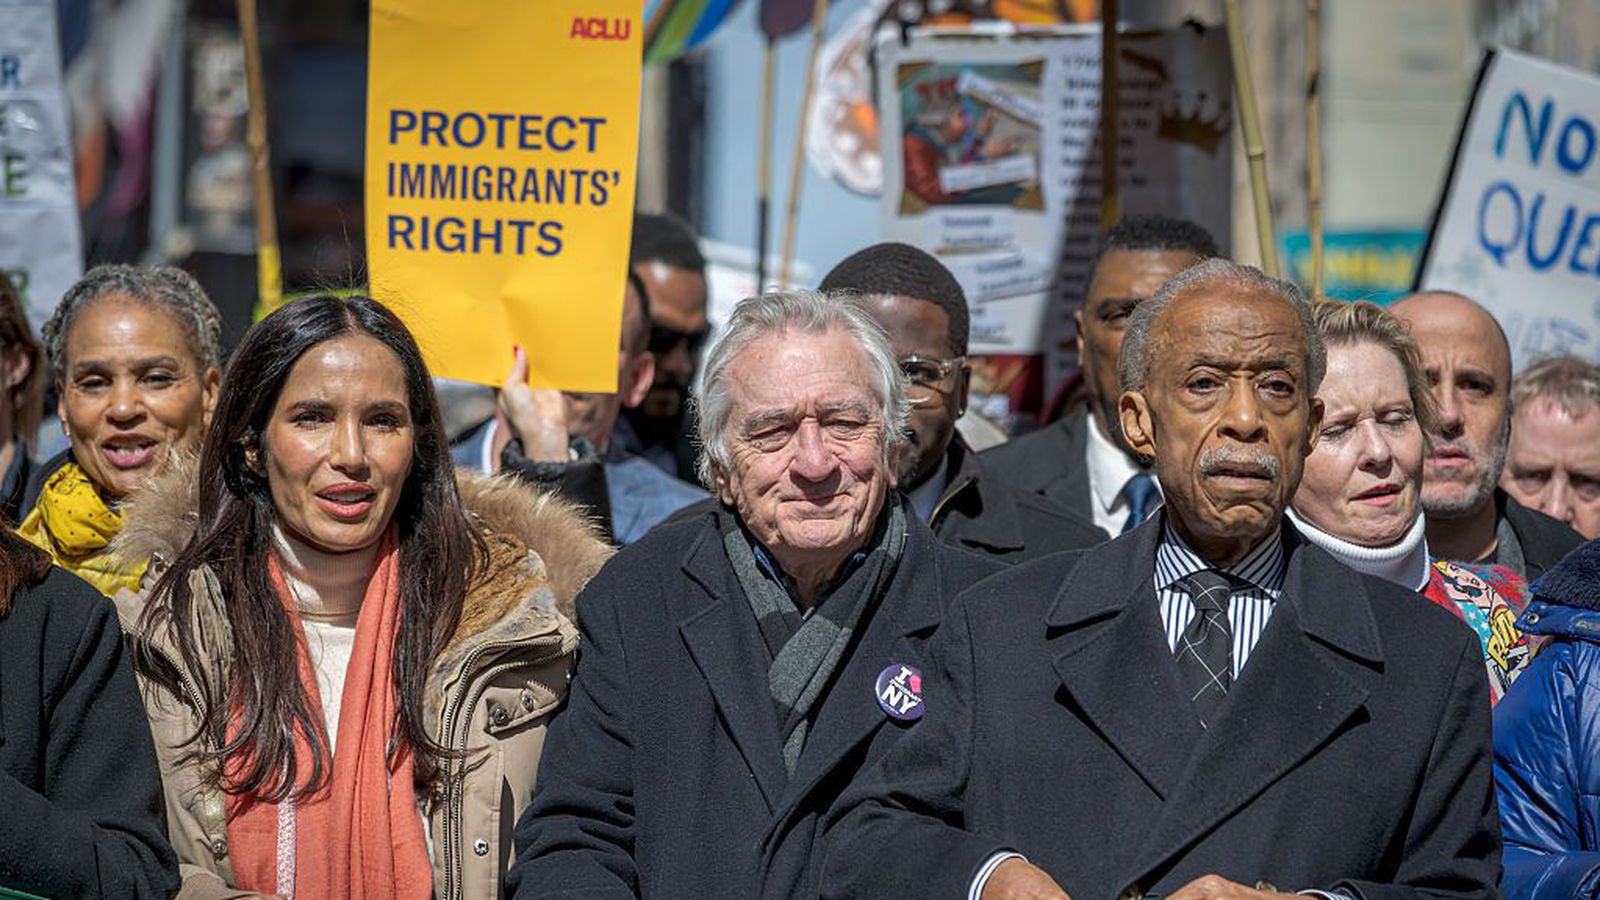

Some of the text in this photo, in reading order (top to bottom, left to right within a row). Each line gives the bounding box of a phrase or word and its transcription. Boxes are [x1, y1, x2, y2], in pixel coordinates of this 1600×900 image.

[570, 17, 631, 41] ACLU
[388, 109, 607, 153] PROTECT
[387, 162, 620, 207] IMMIGRANTS’
[387, 214, 564, 257] RIGHTS
[1478, 179, 1600, 281] QUE
[881, 683, 920, 715] NY
